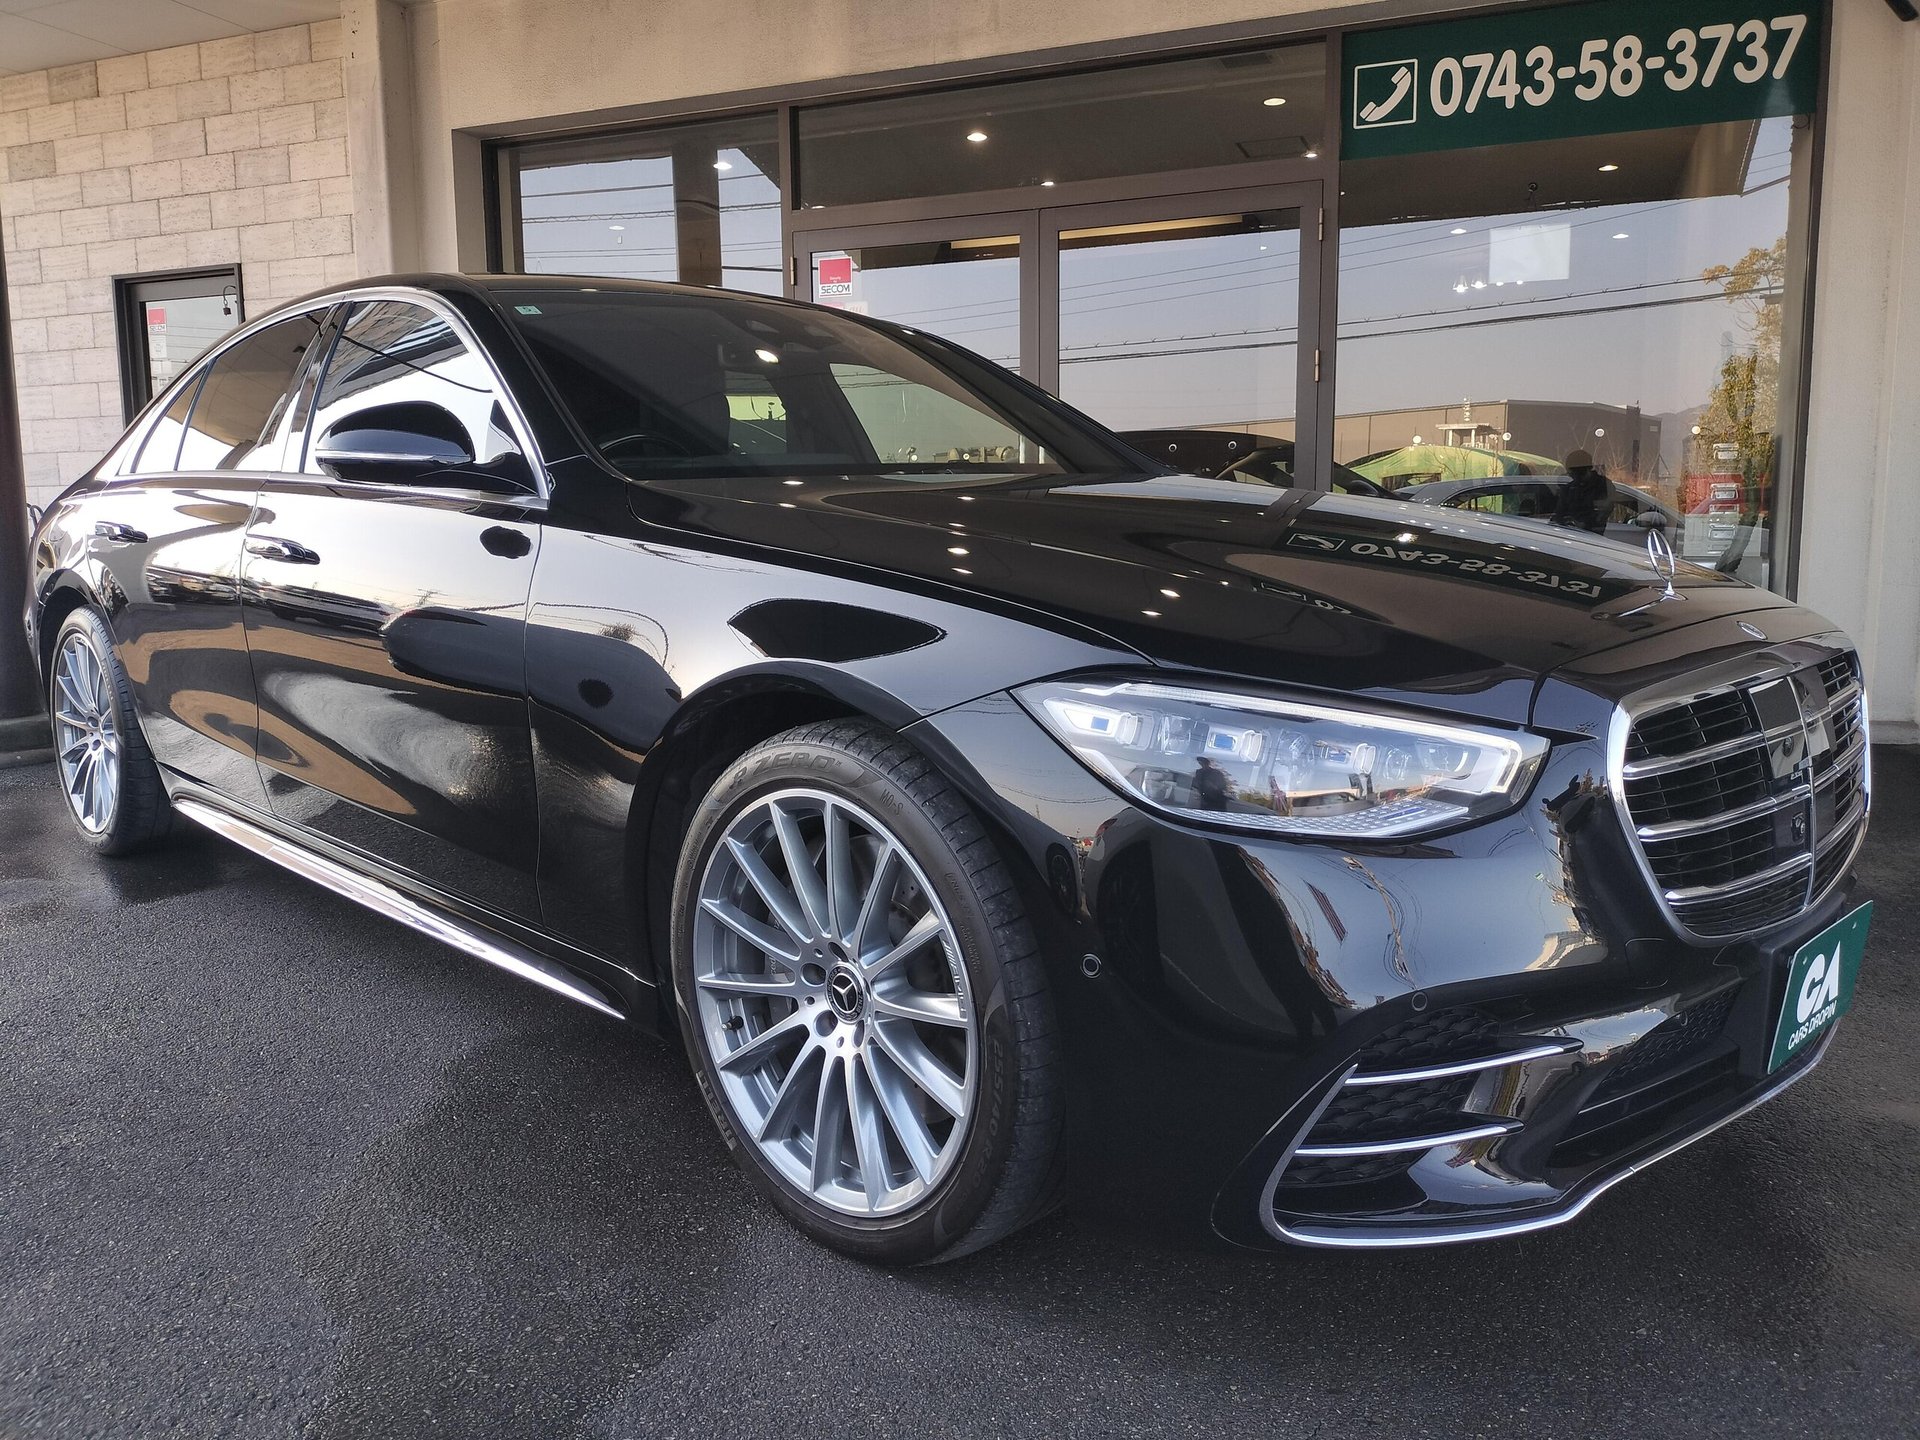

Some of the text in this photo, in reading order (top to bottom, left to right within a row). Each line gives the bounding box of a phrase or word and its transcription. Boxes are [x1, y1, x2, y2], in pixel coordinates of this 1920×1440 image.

[1430, 14, 1808, 117] 0743-58-3737
[821, 284, 851, 294] SECOM
[752, 752, 835, 776] ZERO
[1788, 1000, 1837, 1050] CARS DROPIN
